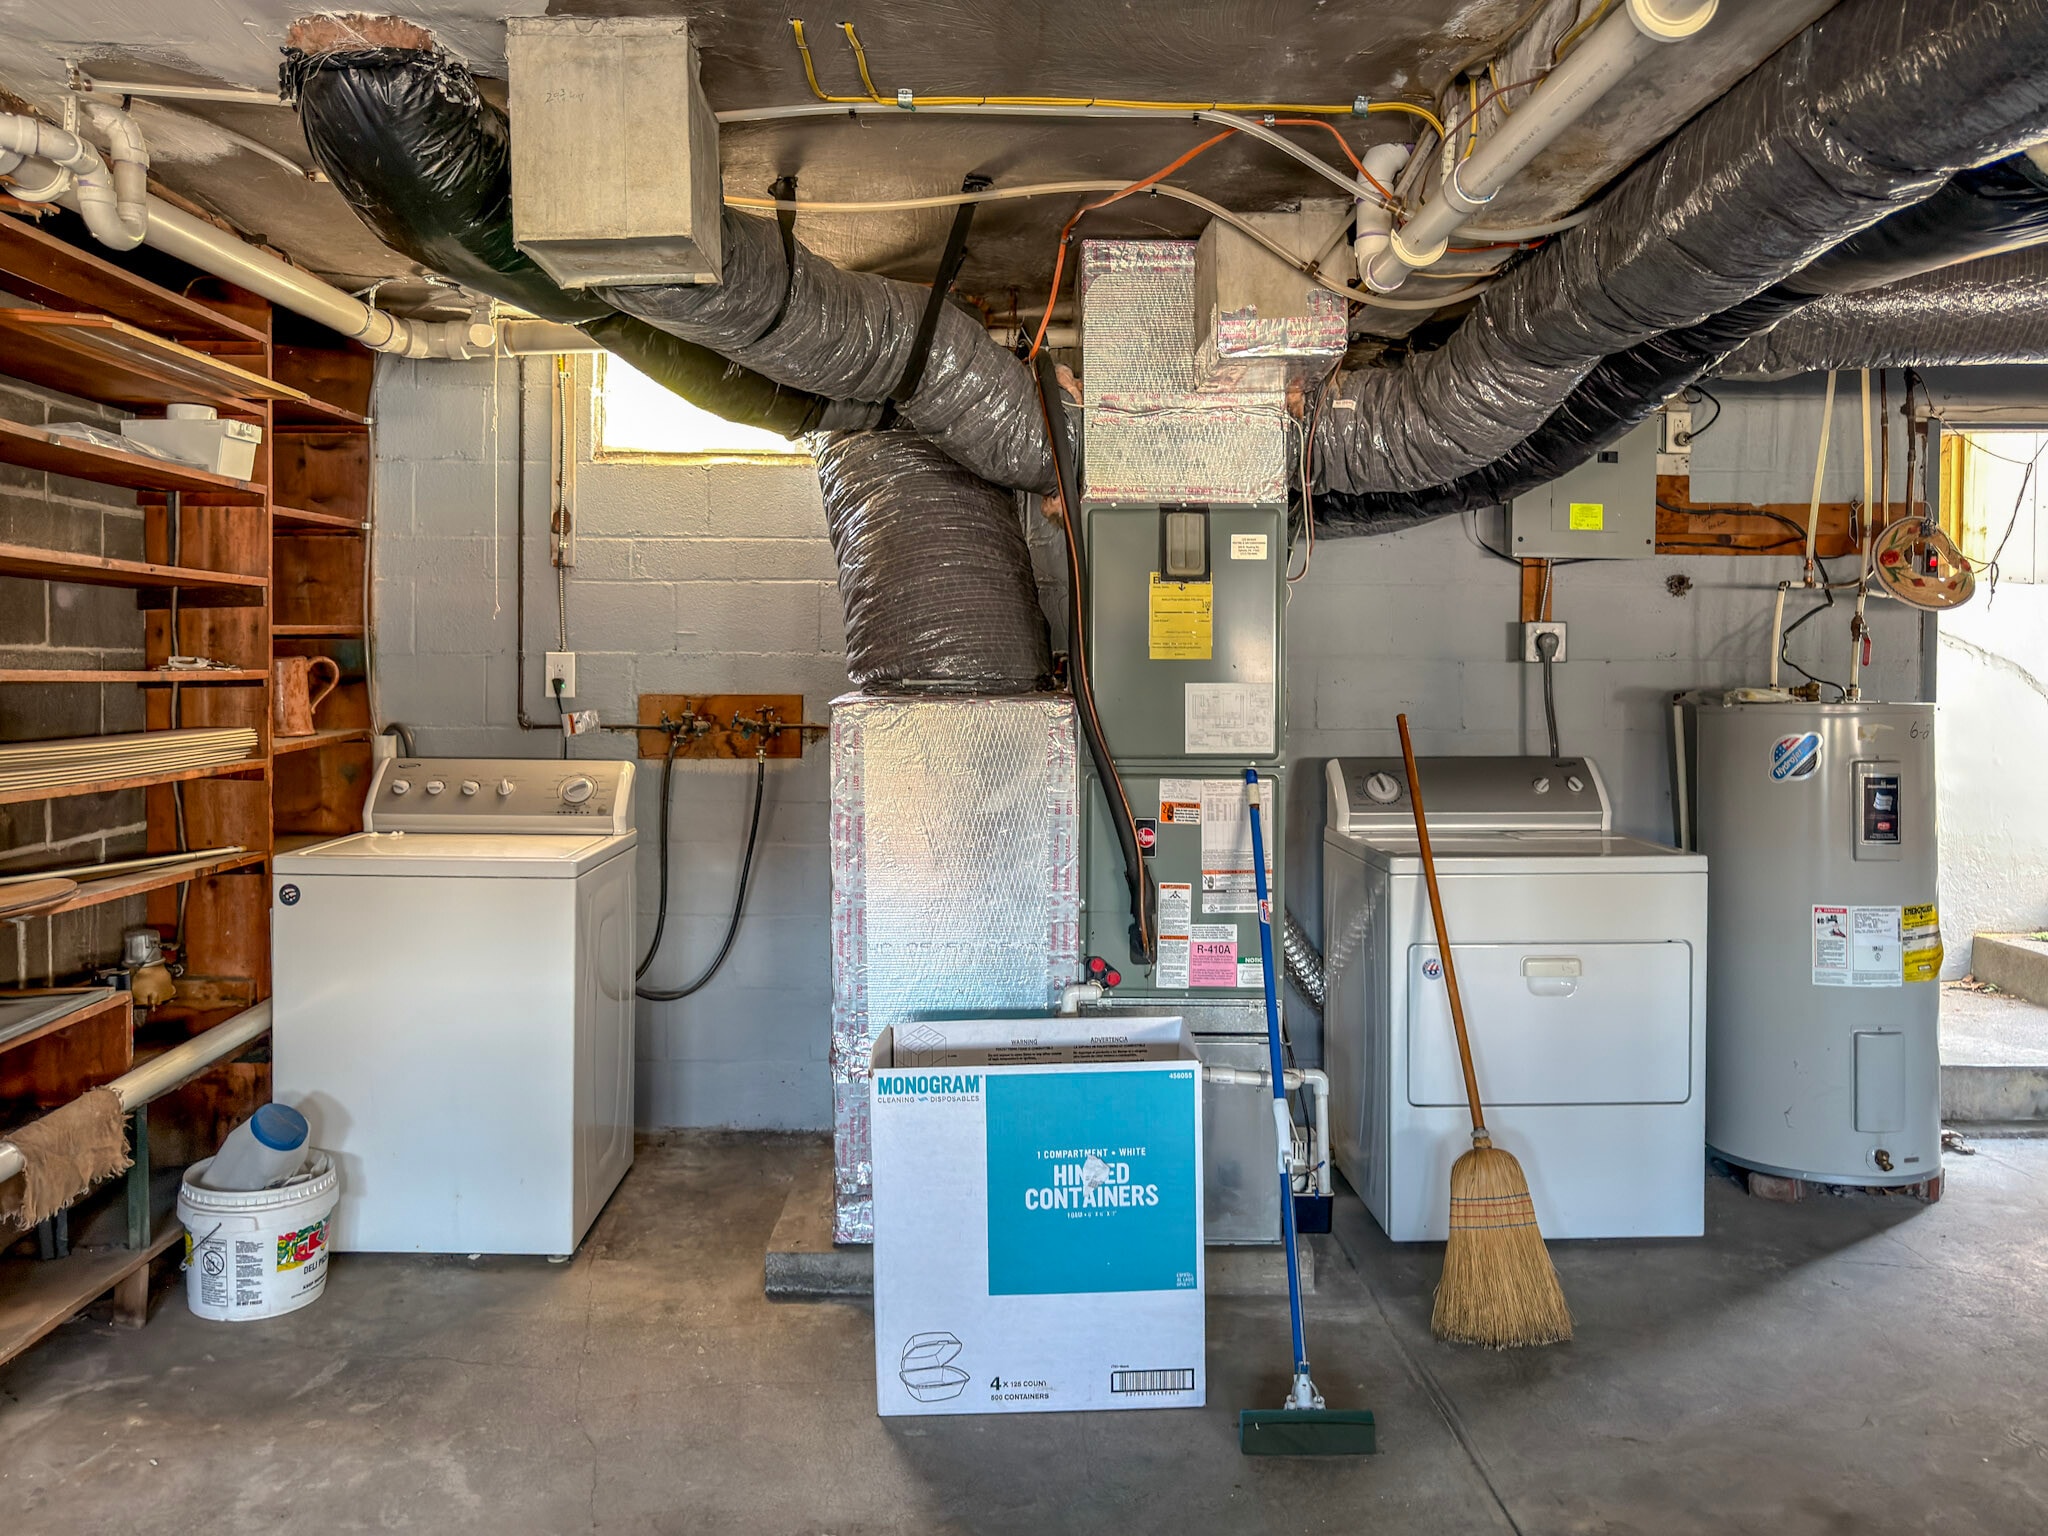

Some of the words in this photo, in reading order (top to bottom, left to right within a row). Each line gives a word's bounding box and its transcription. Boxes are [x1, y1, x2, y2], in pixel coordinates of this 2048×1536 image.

[1197, 944, 1231, 954] R-410A
[1090, 1036, 1129, 1044] ADVERTENCIA
[877, 1074, 980, 1096] MONOGRAM
[877, 1096, 915, 1104] CLEANING
[930, 1095, 980, 1103] DISPOSABLES
[1037, 1151, 1041, 1160] 1
[1043, 1147, 1109, 1160] COMPARTMENT
[1118, 1147, 1147, 1157] WHITE
[1053, 1162, 1131, 1187] HINED
[1025, 1183, 1160, 1211] CONTAINERS
[303, 1261, 318, 1275] DELI
[990, 1376, 1001, 1391] 4
[1004, 1392, 1049, 1400] CONTAINERS
